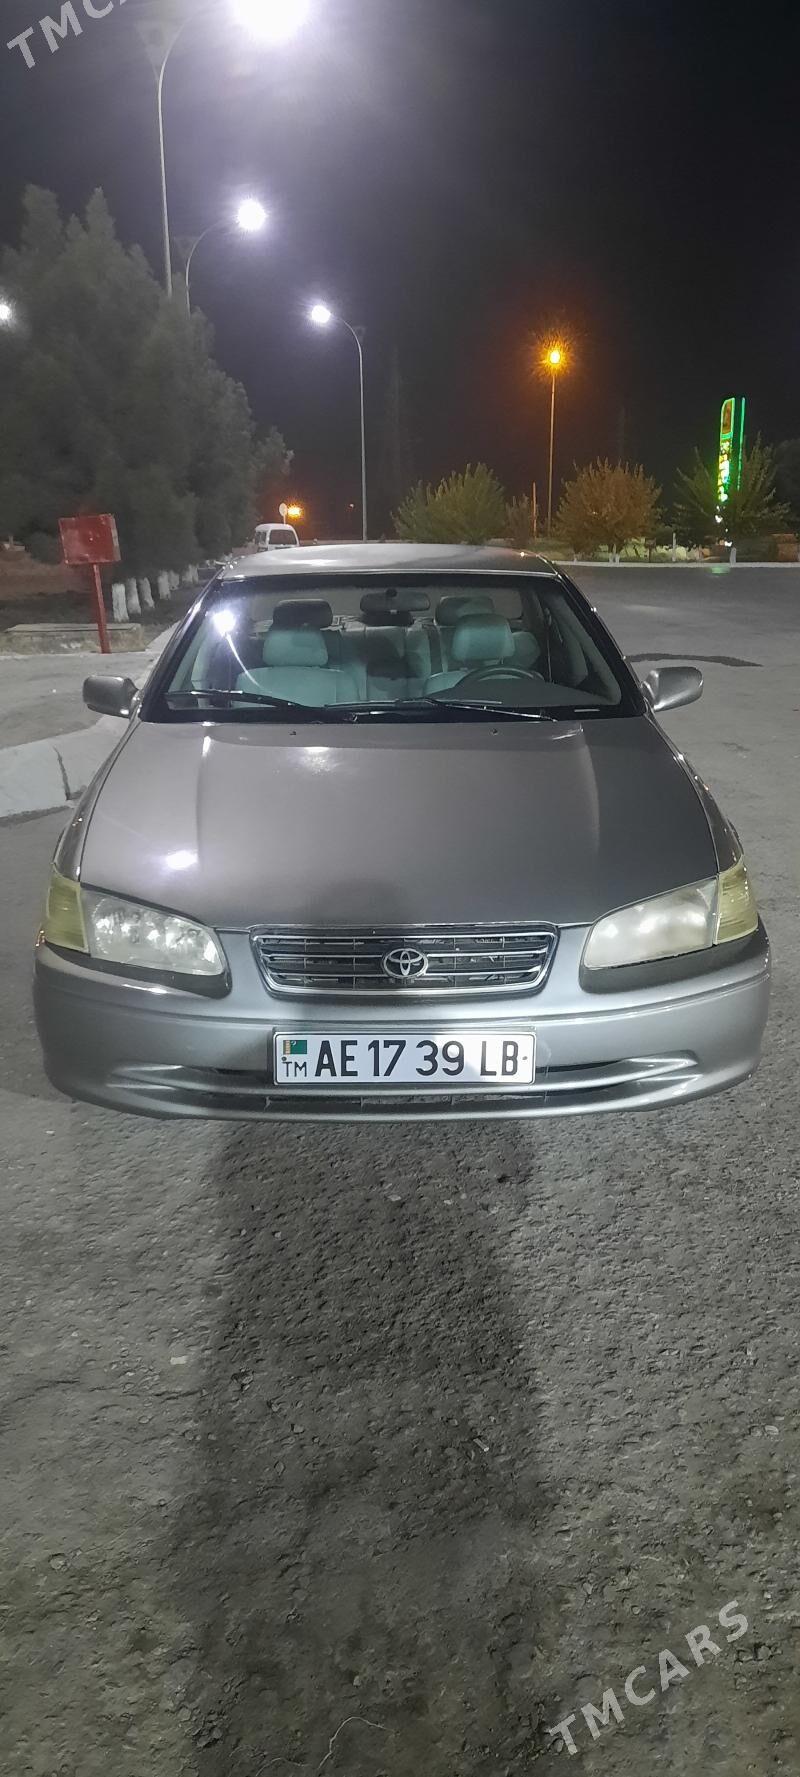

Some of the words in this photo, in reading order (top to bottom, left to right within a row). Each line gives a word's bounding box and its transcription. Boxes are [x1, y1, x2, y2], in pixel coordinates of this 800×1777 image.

[282, 1061, 308, 1077] TM
[315, 1040, 358, 1077] AE
[367, 1040, 406, 1077] 17
[416, 1040, 464, 1077] 39
[480, 1040, 519, 1076] LB
